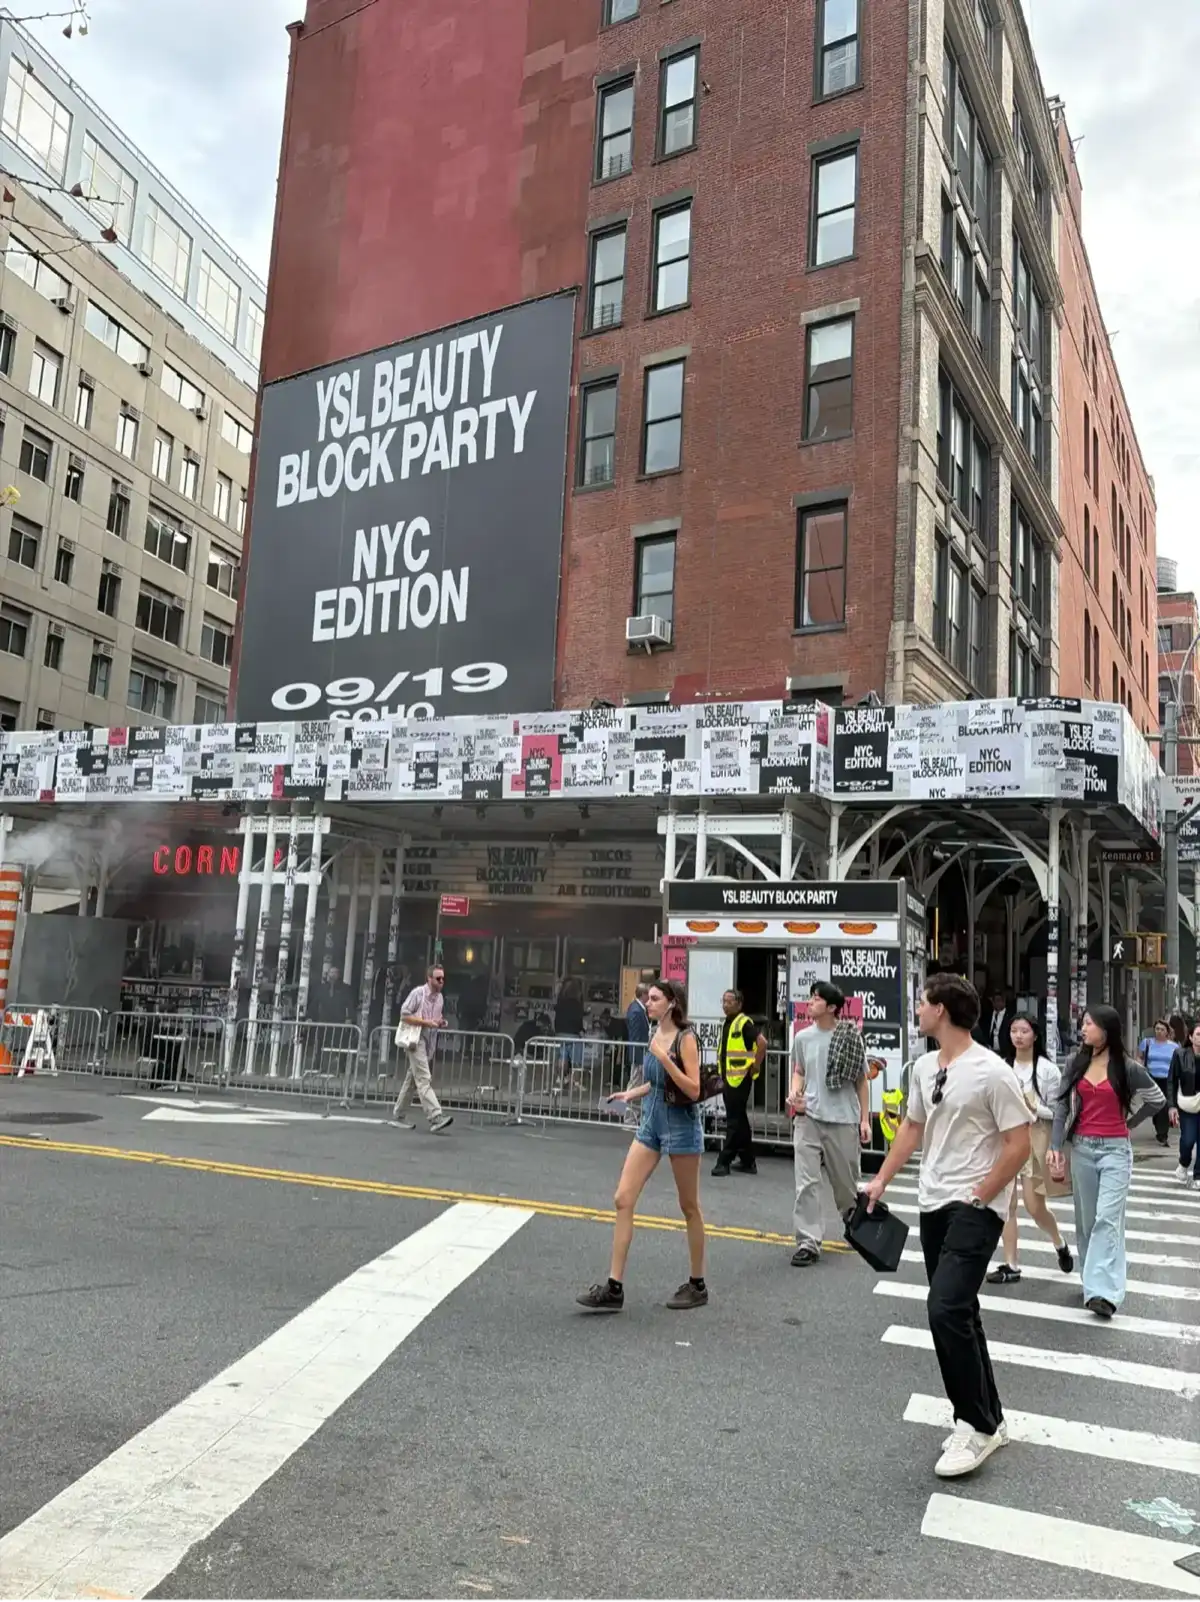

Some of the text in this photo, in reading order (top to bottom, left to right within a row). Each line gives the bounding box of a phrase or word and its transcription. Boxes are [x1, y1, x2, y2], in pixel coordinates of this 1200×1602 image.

[316, 324, 504, 442] YSL BEAUTY
[276, 390, 538, 507] BLOCK PARTY
[352, 516, 432, 582] NYC
[312, 566, 470, 642] EDITION
[271, 662, 508, 711] 09/19
[1021, 697, 1078, 706] 09/19
[593, 708, 616, 720] BEAUTY
[647, 705, 681, 714] EDITION
[704, 704, 743, 718] YSL BEAUTY
[844, 708, 885, 724] YSL BEAUTY
[302, 722, 331, 733] YSL BEAUTY
[599, 718, 623, 729] PARTY
[696, 716, 750, 729] BLOCK PARTY
[836, 721, 893, 735] BLOCK PARTY
[135, 731, 160, 740] EDITION
[958, 722, 1022, 737] BLOCK PARTY
[1069, 724, 1081, 739] YSL
[263, 734, 282, 745] BEAUTY
[295, 733, 335, 743] BLOCK PARTY
[1098, 735, 1116, 743] EDITION
[268, 745, 287, 753] PARTY
[1063, 738, 1089, 751] BLOCK
[529, 748, 545, 757] NYC
[854, 745, 873, 757] NYC
[980, 748, 1000, 761] NYC
[761, 756, 809, 767] BLOCK PARTY
[845, 756, 881, 769] EDITION
[920, 756, 957, 769] YSL BEAUTY
[969, 759, 1011, 773] EDITION
[260, 765, 272, 773] NYC
[711, 769, 740, 778] EDITION
[913, 768, 963, 778] BLOCK PARTY
[304, 777, 325, 787] PARTY
[463, 773, 502, 782] BLOCK PARTY
[776, 777, 793, 786] NYC
[350, 782, 392, 791] BLOCK PARTY
[1061, 783, 1078, 791] EDITION
[1084, 778, 1107, 792] ITION
[232, 790, 248, 799] BEAUTY
[476, 790, 488, 799] NYC
[929, 788, 945, 798] NYC
[487, 846, 539, 868] YSL BEAUTY
[1102, 851, 1154, 861] Kenmare St
[476, 866, 548, 882] BLOCK PARTY
[558, 883, 577, 896] AIR
[723, 890, 838, 905] YSL BEAUTY BLOCK PARTY
[797, 947, 824, 957] YSL BEAUTY
[841, 949, 888, 966] YSL BEAUTY
[792, 955, 828, 964] BLOCK PARTY
[804, 970, 816, 980] NYC
[832, 965, 898, 979] BLOCK PARTY
[863, 1006, 886, 1020] TION
[699, 1023, 722, 1038] BEAUT
